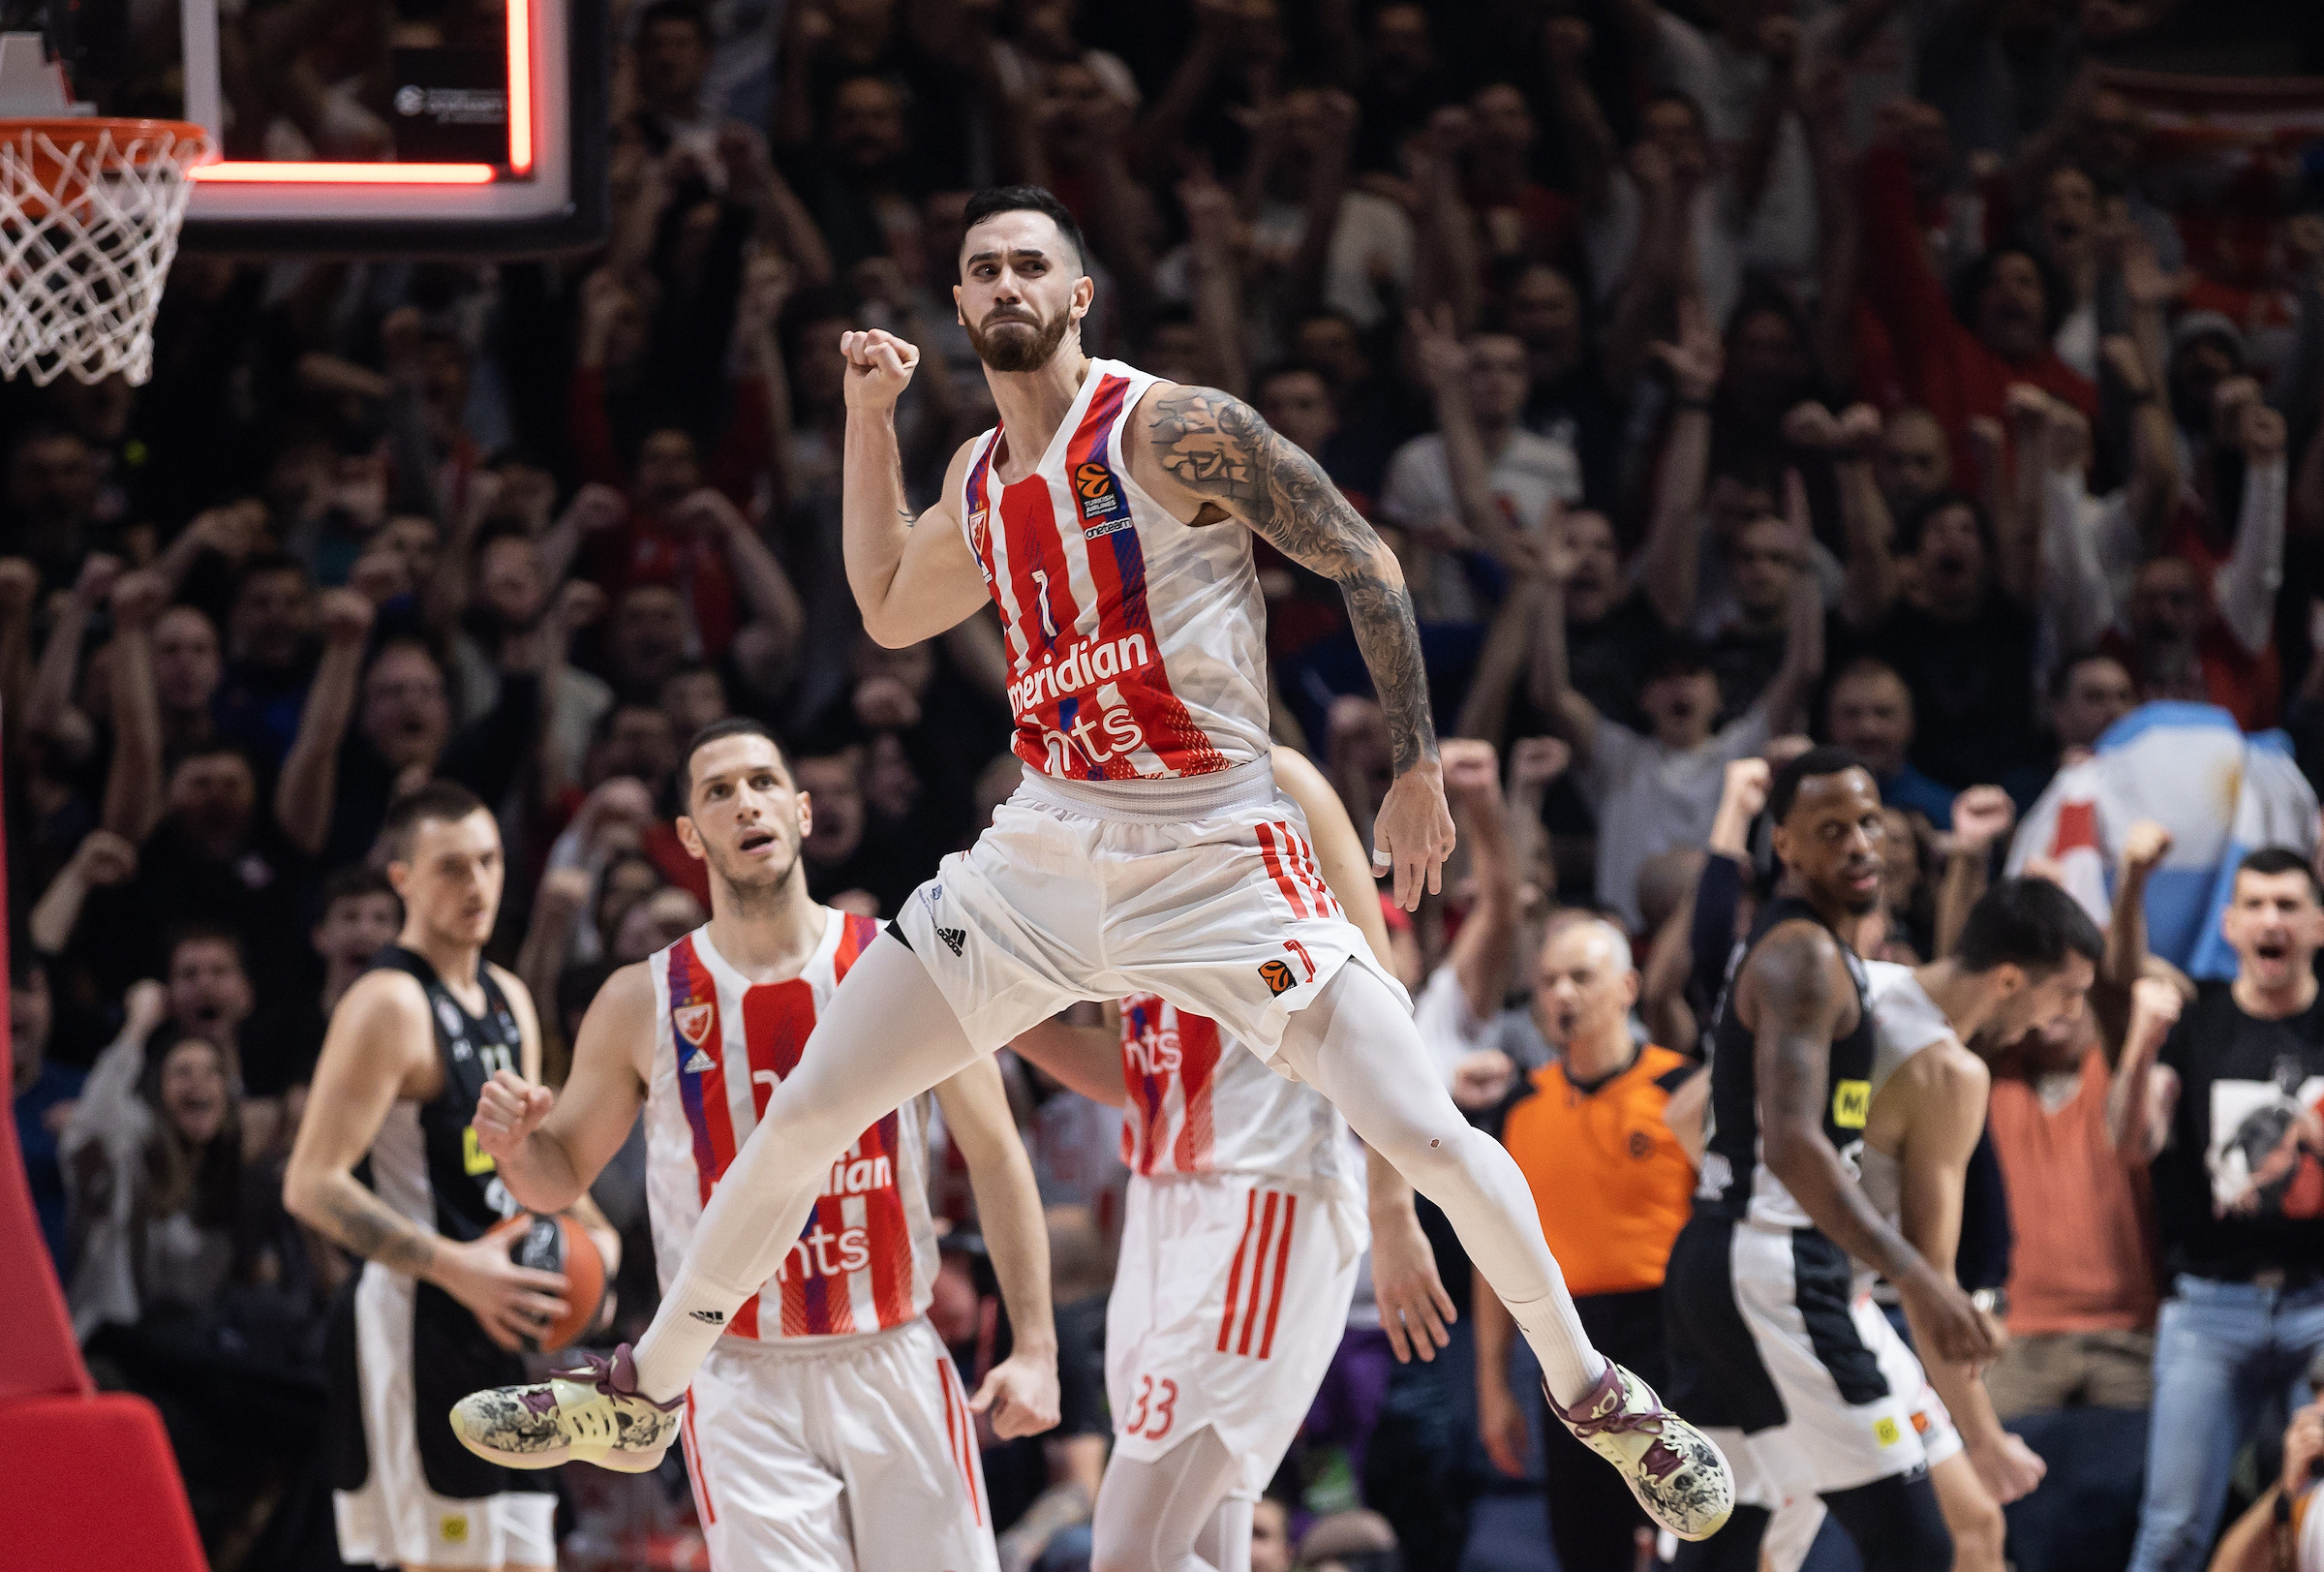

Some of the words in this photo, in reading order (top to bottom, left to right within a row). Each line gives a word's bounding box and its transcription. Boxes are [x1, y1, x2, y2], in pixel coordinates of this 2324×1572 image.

[1086, 518, 1131, 539] oneteam
[1007, 633, 1148, 720] meridian
[936, 928, 963, 957] adidas
[1126, 1374, 1179, 1441] 33
